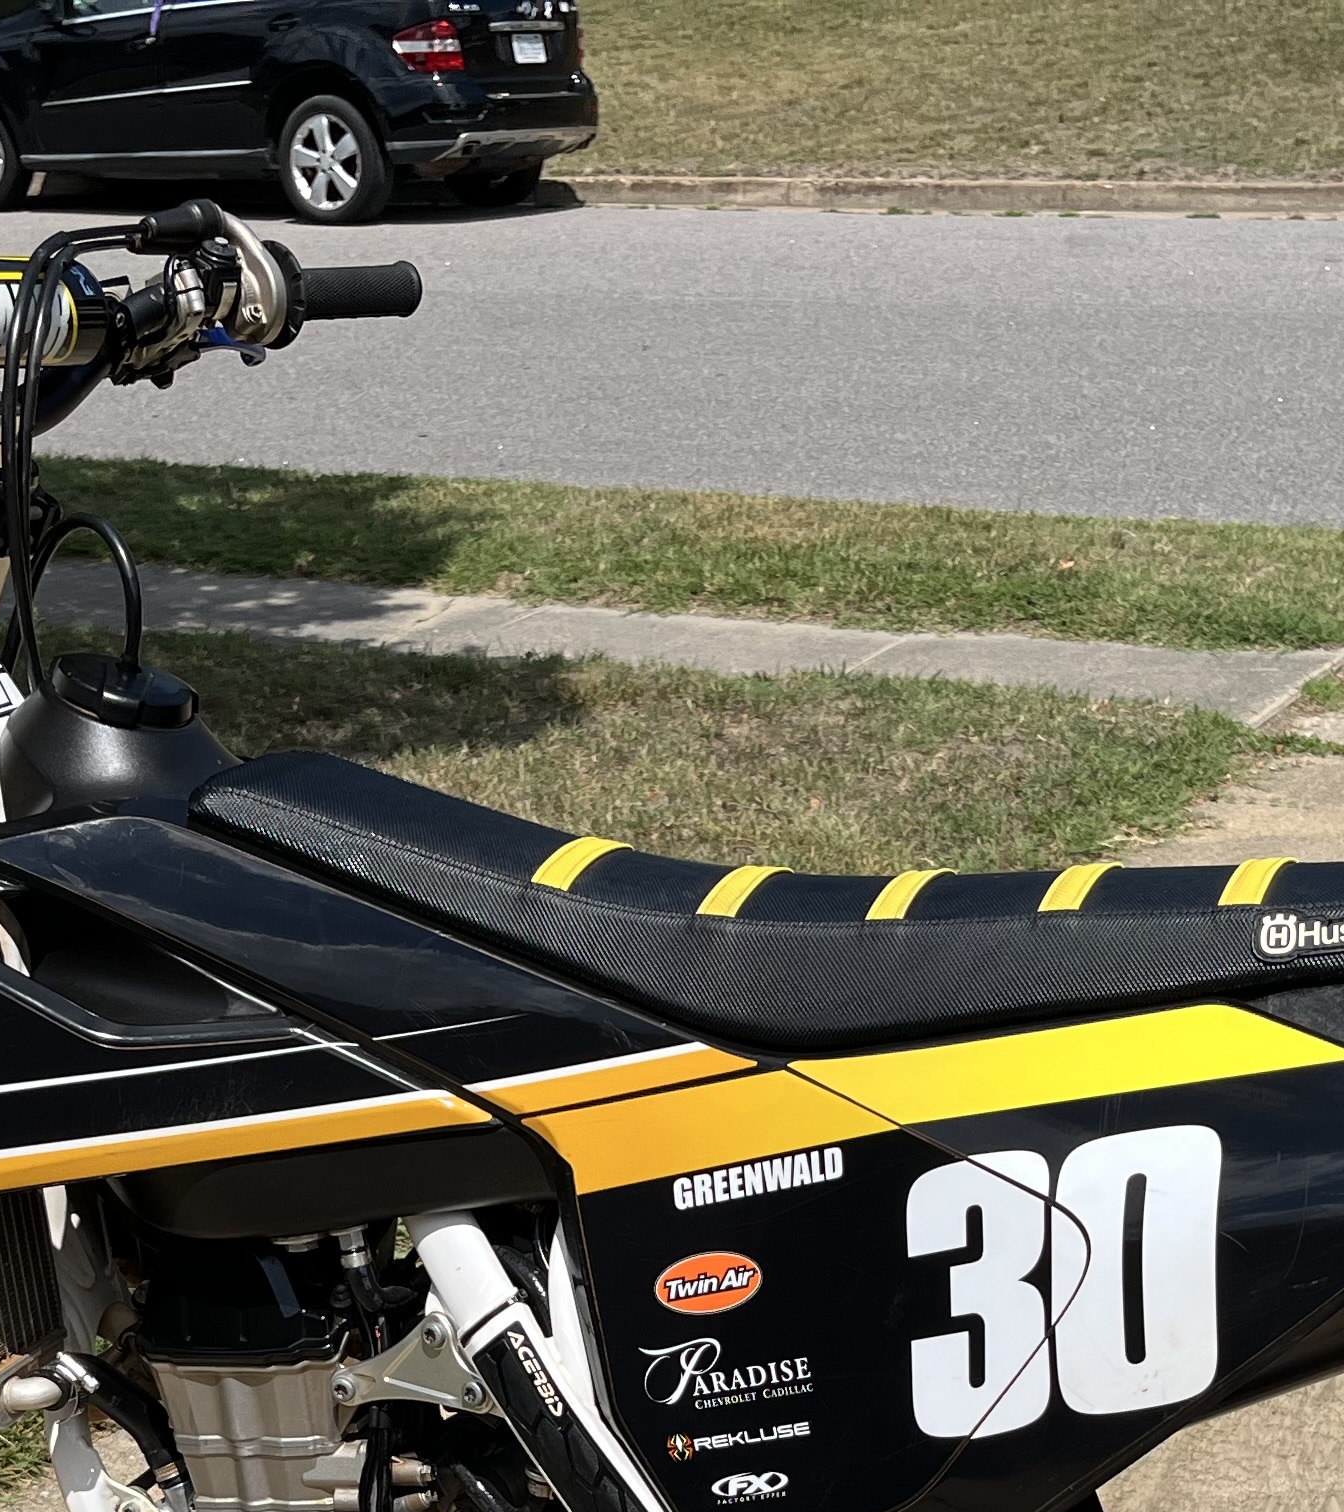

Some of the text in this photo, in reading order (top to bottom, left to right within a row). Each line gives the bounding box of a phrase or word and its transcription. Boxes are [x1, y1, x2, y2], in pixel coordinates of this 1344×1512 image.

[673, 1147, 843, 1210] GREENWALD
[666, 1266, 755, 1300] Twin Air
[906, 1125, 1222, 1439] 30
[638, 1337, 811, 1405] PARADISE
[695, 1382, 814, 1410] CHEVROLET CADILLAC
[693, 1421, 811, 1451] REKLUSE
[726, 1472, 775, 1497] FX
